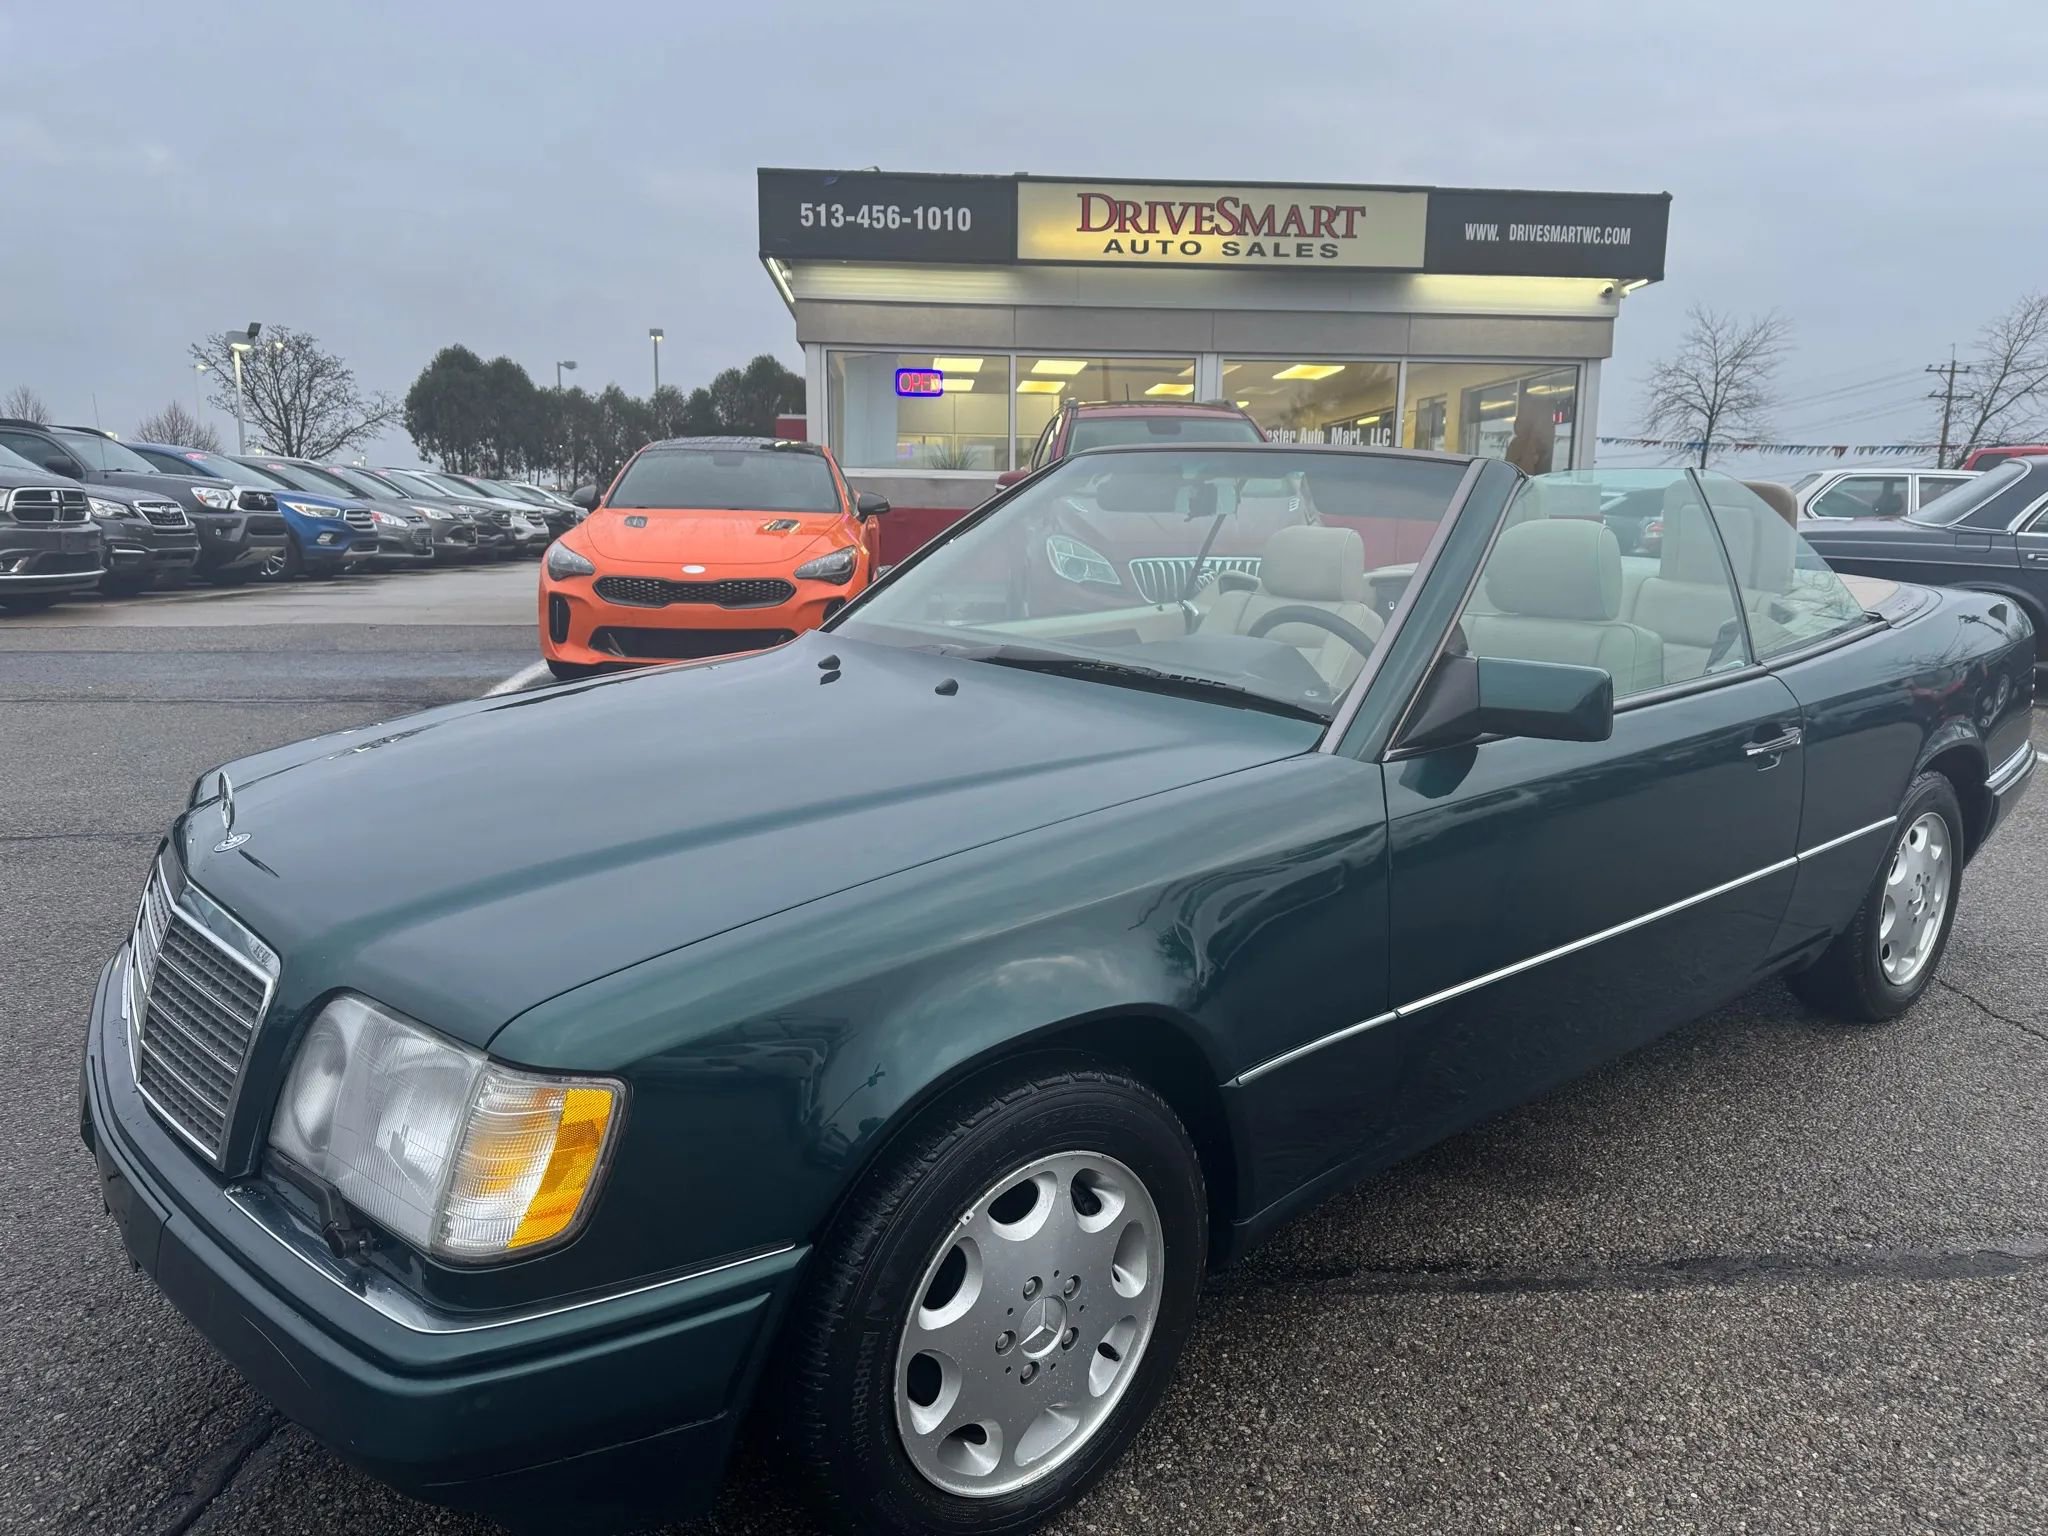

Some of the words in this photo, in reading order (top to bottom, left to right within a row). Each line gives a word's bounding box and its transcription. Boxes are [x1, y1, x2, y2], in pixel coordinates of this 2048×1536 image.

[800, 203, 972, 232] 513-456-1010
[1077, 193, 1366, 238] DRIVESMART
[1465, 223, 1500, 241] WWW.
[1509, 224, 1632, 245] DRIVESMARTWC.COM
[1103, 239, 1202, 256] AUTO
[1222, 241, 1339, 258] SALES
[899, 372, 942, 393] OPEN
[1300, 427, 1325, 444] Auto
[1370, 428, 1391, 447] LLC
